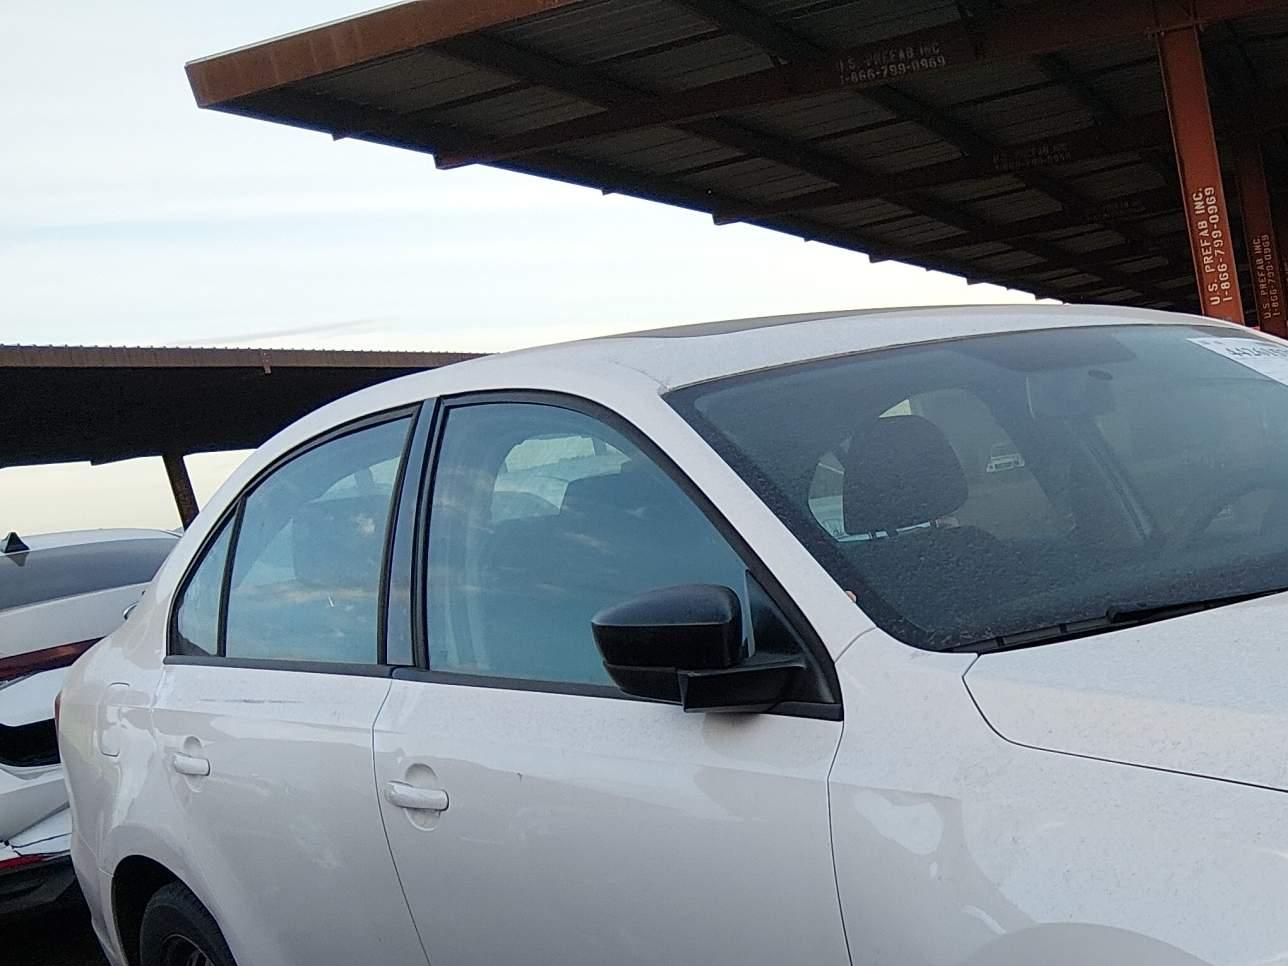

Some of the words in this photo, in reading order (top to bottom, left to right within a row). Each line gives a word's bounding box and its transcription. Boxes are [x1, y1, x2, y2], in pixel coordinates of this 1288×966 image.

[1192, 187, 1206, 215] INC.
[1197, 220, 1216, 273] PREFAB
[1204, 186, 1233, 302] 1-866-799-0969
[1208, 279, 1221, 305] U.S.
[1255, 258, 1268, 296] PREFAB
